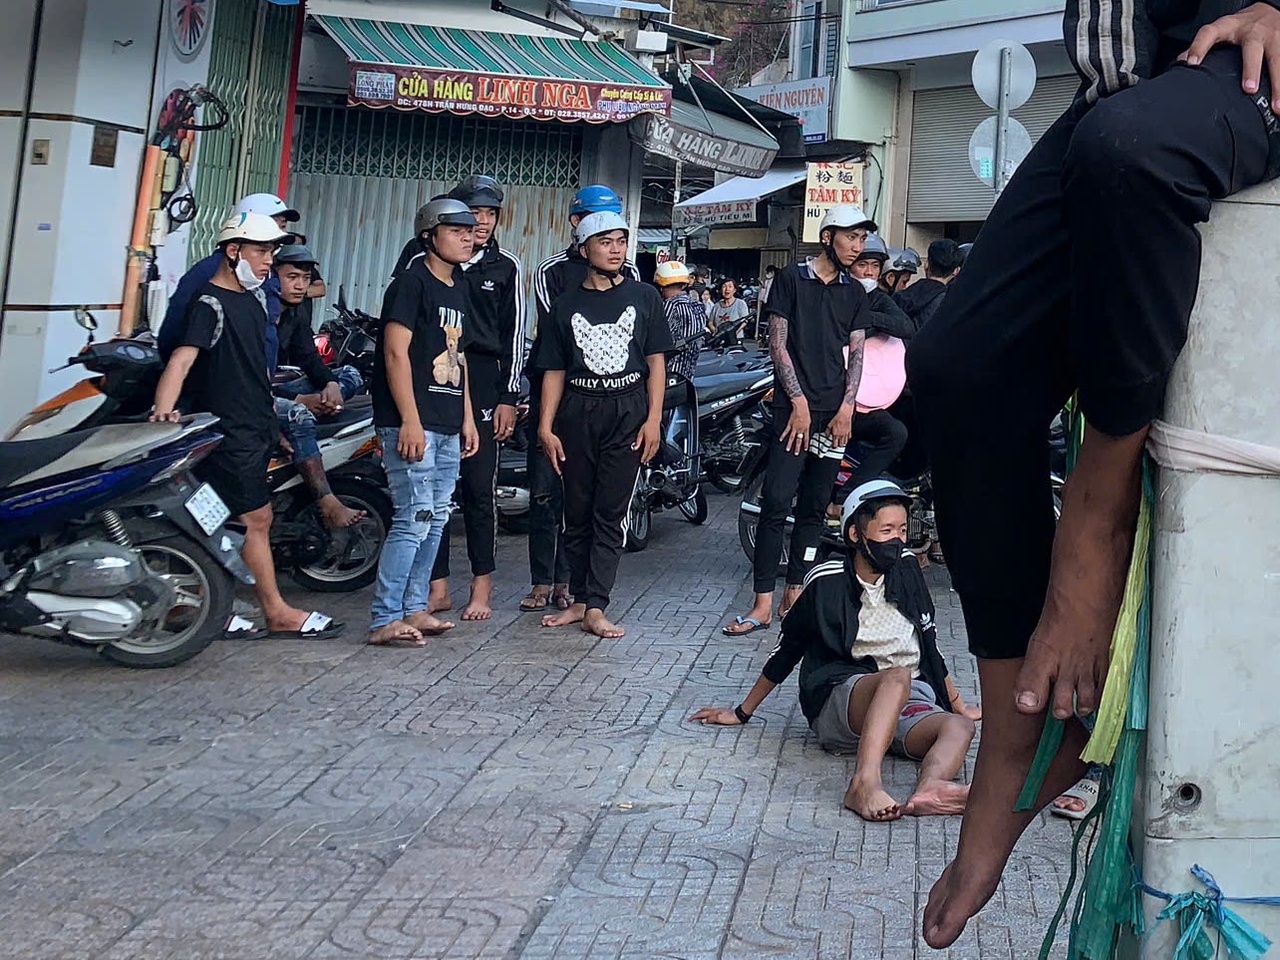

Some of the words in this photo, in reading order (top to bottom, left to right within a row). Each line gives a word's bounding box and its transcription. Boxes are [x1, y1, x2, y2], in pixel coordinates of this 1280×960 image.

[398, 71, 429, 98] CỬA
[433, 76, 474, 101] HÀNG
[477, 76, 537, 105] LINH
[543, 82, 592, 110] NGA
[784, 83, 825, 109] NGUYÊN
[676, 132, 722, 160] HÀNG
[808, 185, 838, 203] TÂM
[602, 372, 641, 388] VUITTON
